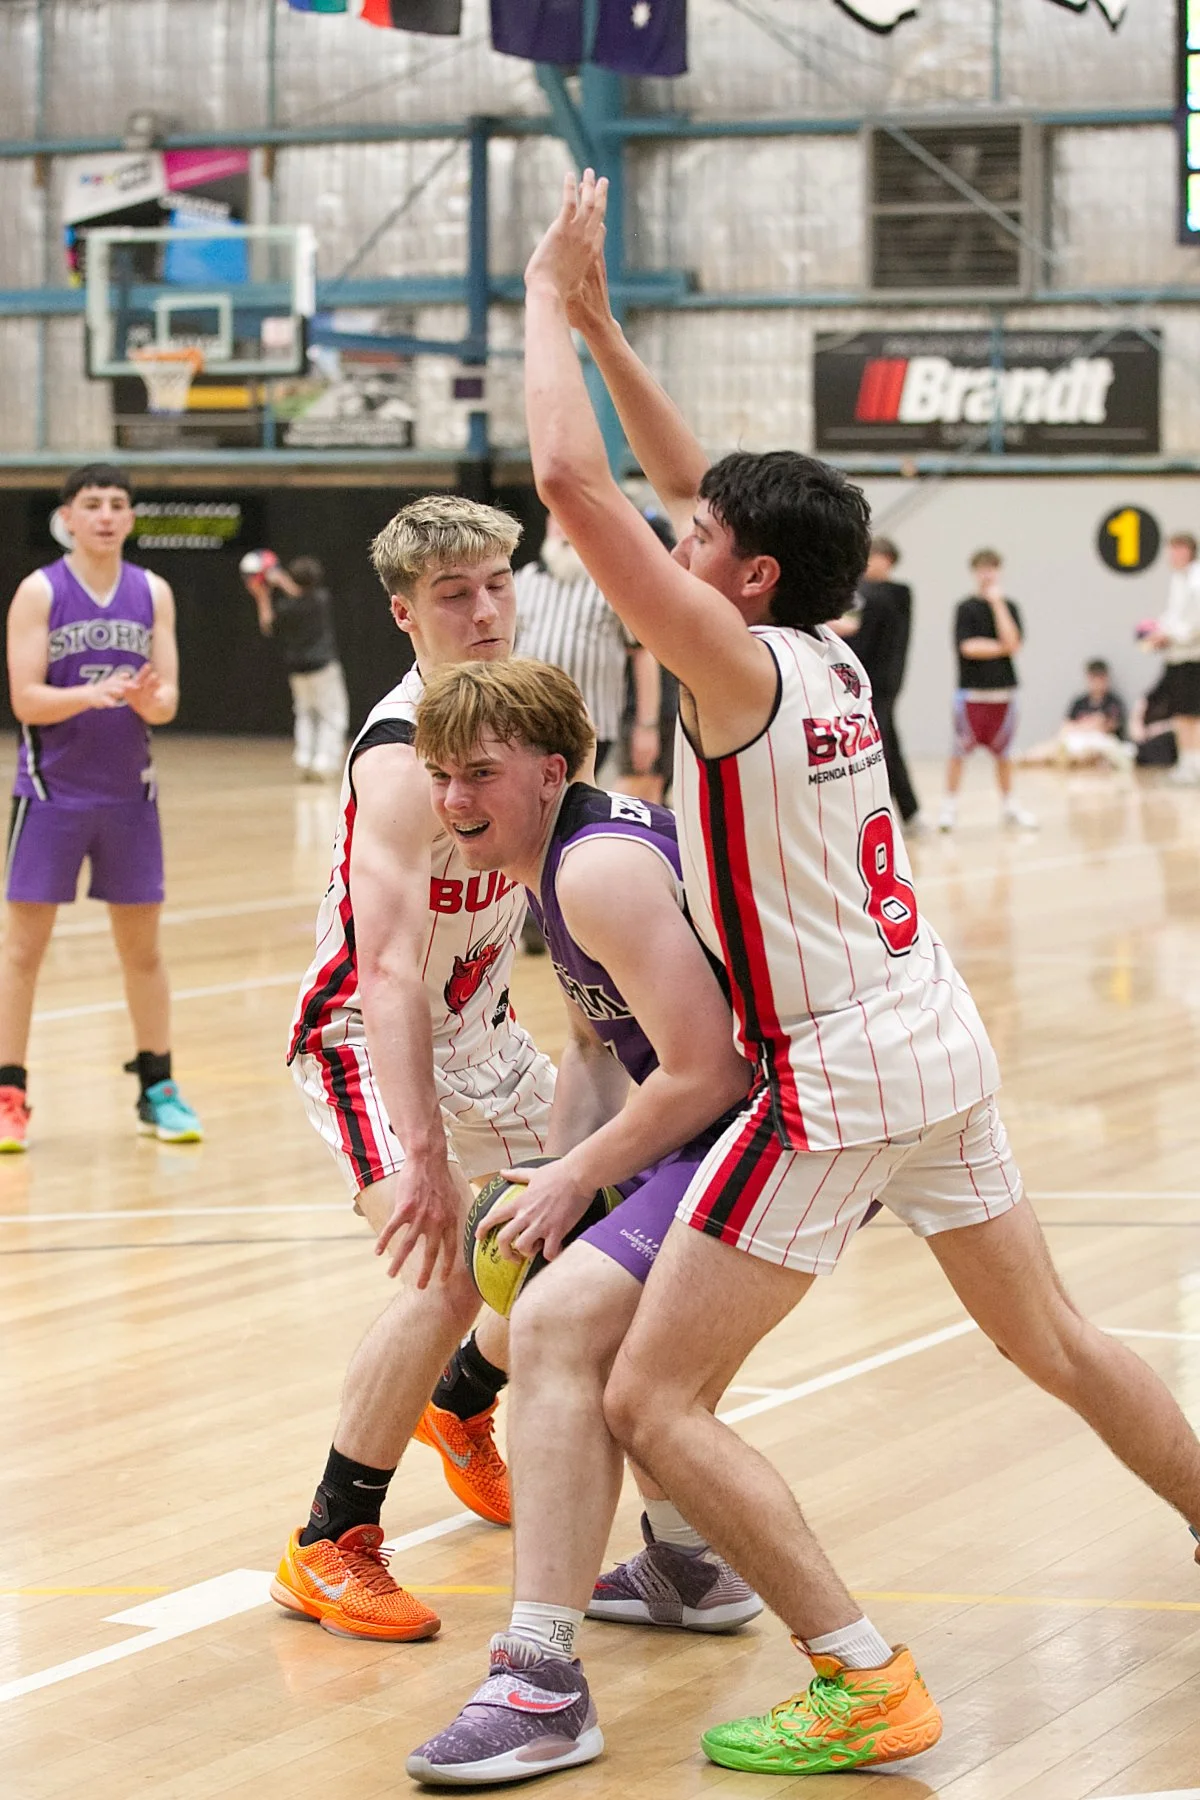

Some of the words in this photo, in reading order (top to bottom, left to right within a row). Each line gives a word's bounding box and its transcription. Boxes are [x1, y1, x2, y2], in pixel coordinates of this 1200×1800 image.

[897, 356, 1114, 424] Brandt
[1107, 507, 1140, 567] 1
[49, 619, 153, 664] STORM
[808, 766, 846, 785] MERNDA
[848, 759, 866, 776] BULLS
[429, 870, 519, 914] BUL
[857, 807, 919, 957] 8
